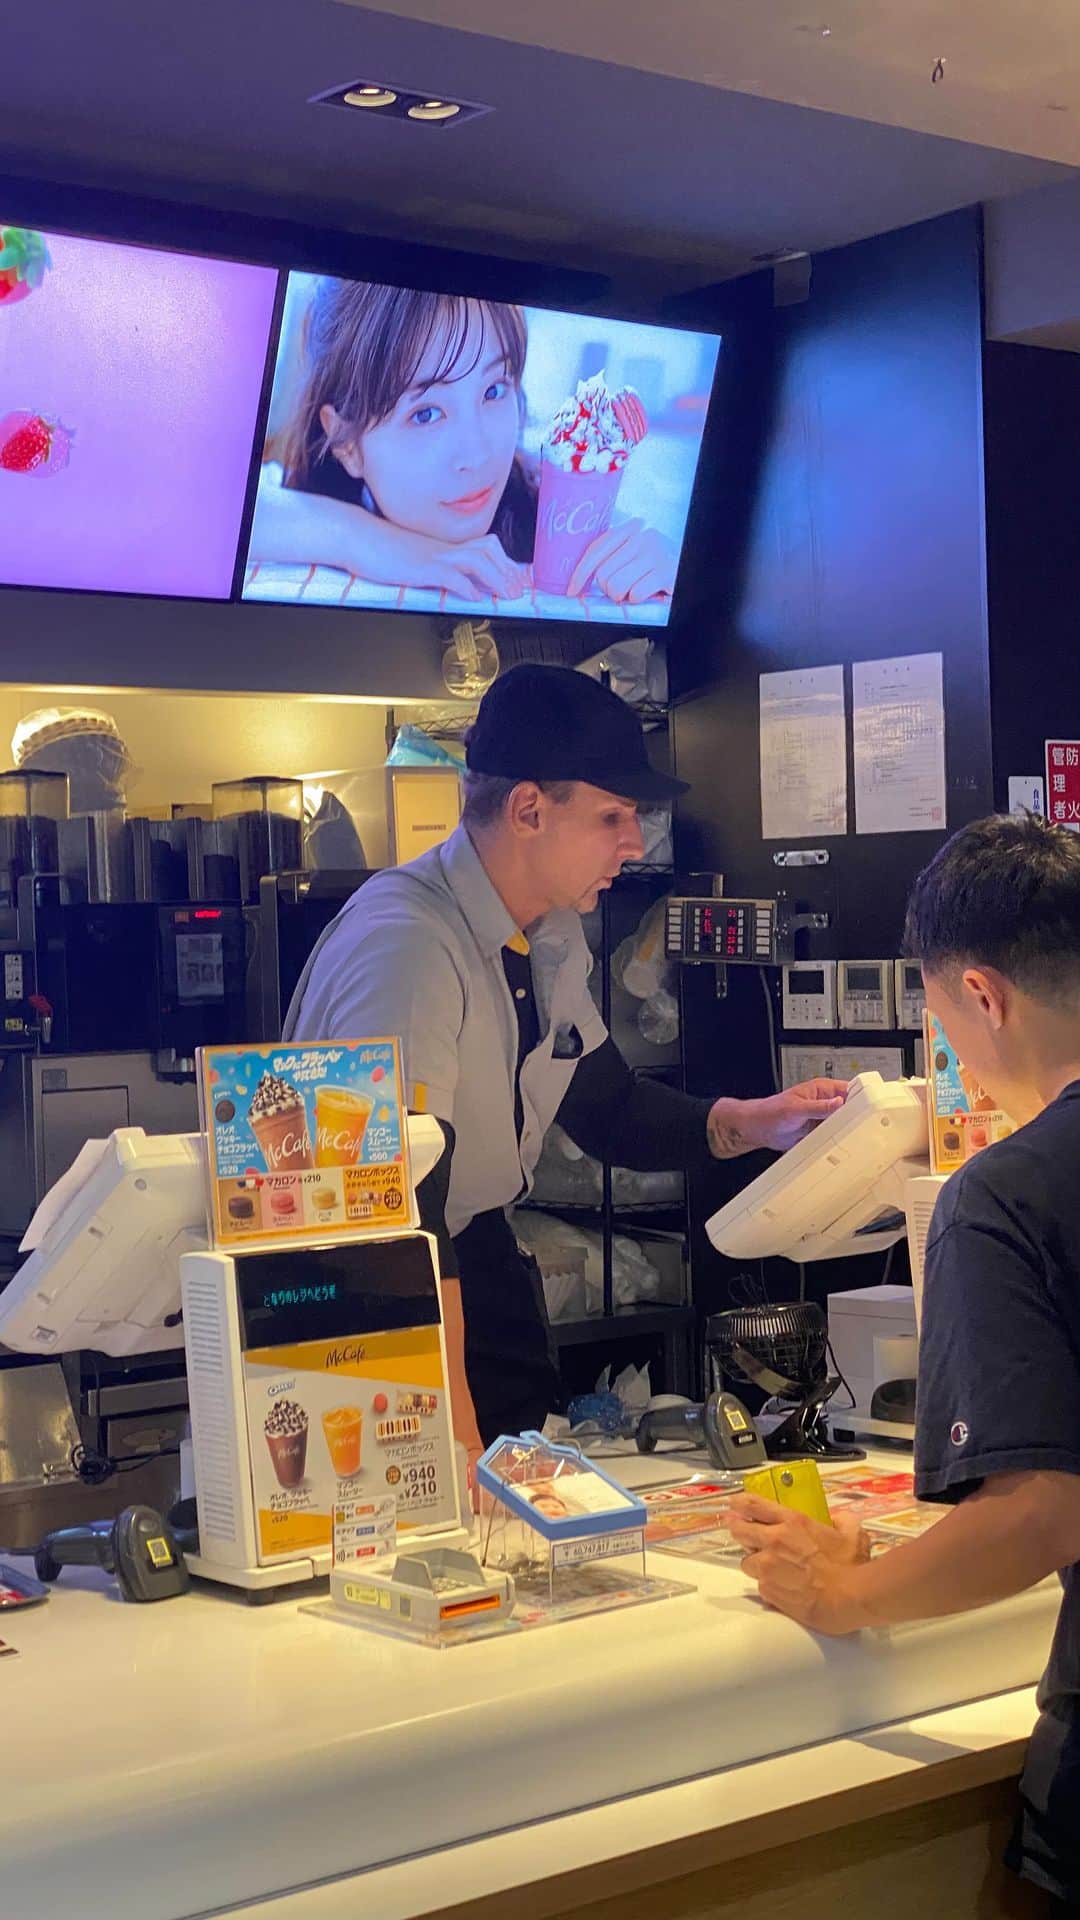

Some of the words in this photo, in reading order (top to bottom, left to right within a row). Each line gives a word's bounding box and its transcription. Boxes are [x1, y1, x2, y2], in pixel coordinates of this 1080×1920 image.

[1052, 747, 1066, 820] 管理者
[1066, 746, 1080, 820] 防火
[266, 1175, 297, 1187] マカロン
[345, 1166, 400, 1179] マカロンボックス
[403, 1465, 436, 1484] ¥940
[405, 1480, 437, 1499] ¥210
